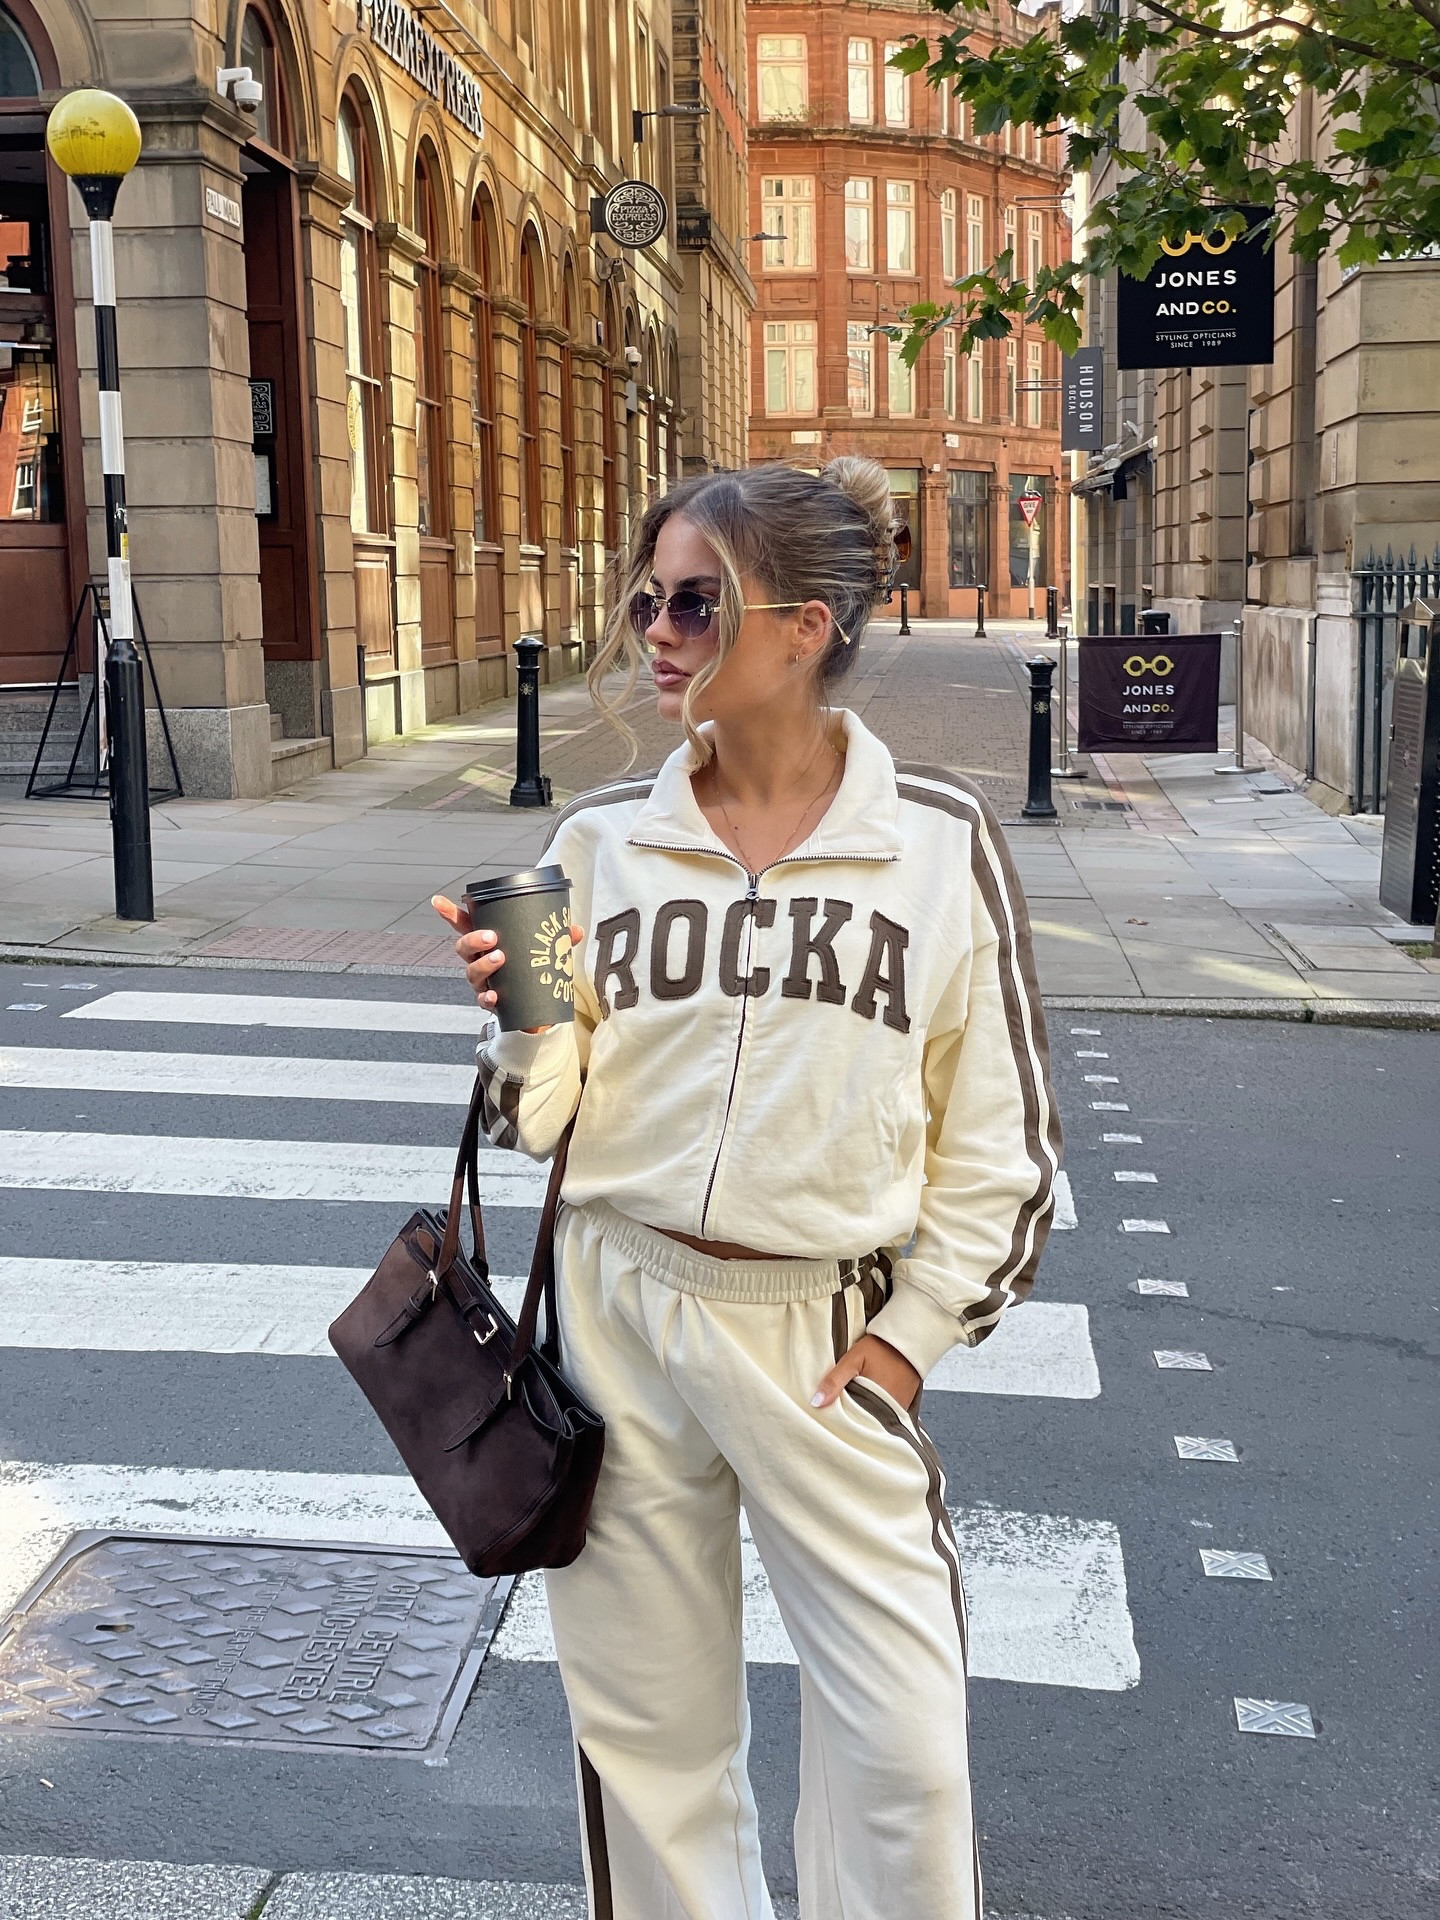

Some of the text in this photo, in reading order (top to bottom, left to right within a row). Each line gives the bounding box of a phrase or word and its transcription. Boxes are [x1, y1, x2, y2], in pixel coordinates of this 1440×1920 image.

[612, 213, 657, 221] EXPRESS
[620, 205, 649, 214] PIZZA
[1155, 269, 1237, 288] JONES
[1155, 331, 1237, 342] STYLING OPTICIANS
[1170, 341, 1193, 349] SINCE
[1068, 384, 1077, 416] SOCIAL
[1079, 365, 1094, 433] HUDSON
[1023, 501, 1036, 509] GIVE
[1122, 684, 1175, 696] JONES
[529, 911, 563, 968] BLACK
[594, 897, 910, 1034] ROCKA
[278, 1579, 378, 1700] MANCHESTER
[326, 1583, 422, 1703] CITY CENTRE
[185, 1676, 228, 1716] THINS
